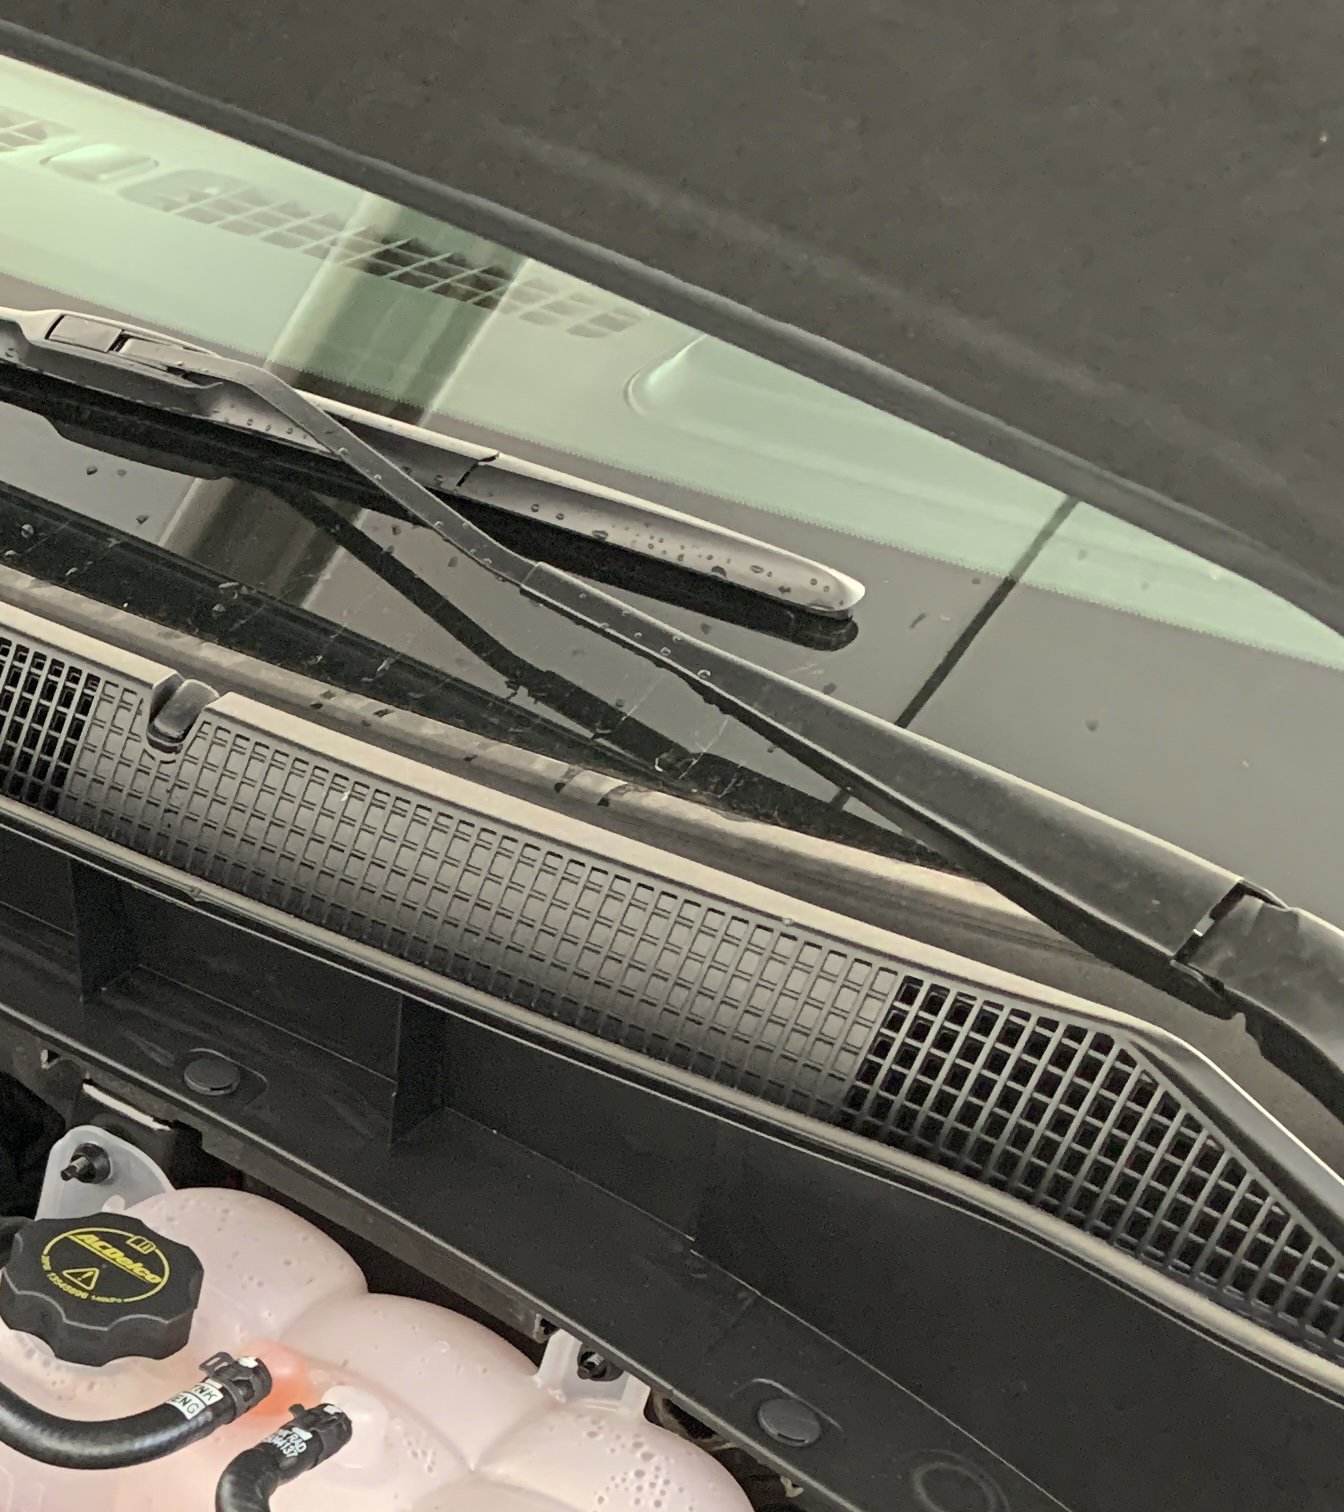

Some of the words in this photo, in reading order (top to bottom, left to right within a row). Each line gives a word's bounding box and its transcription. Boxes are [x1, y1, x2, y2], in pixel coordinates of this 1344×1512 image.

[75, 1233, 163, 1284] ACDelco
[172, 1395, 198, 1413] ENG
[288, 1433, 308, 1454] RAD
